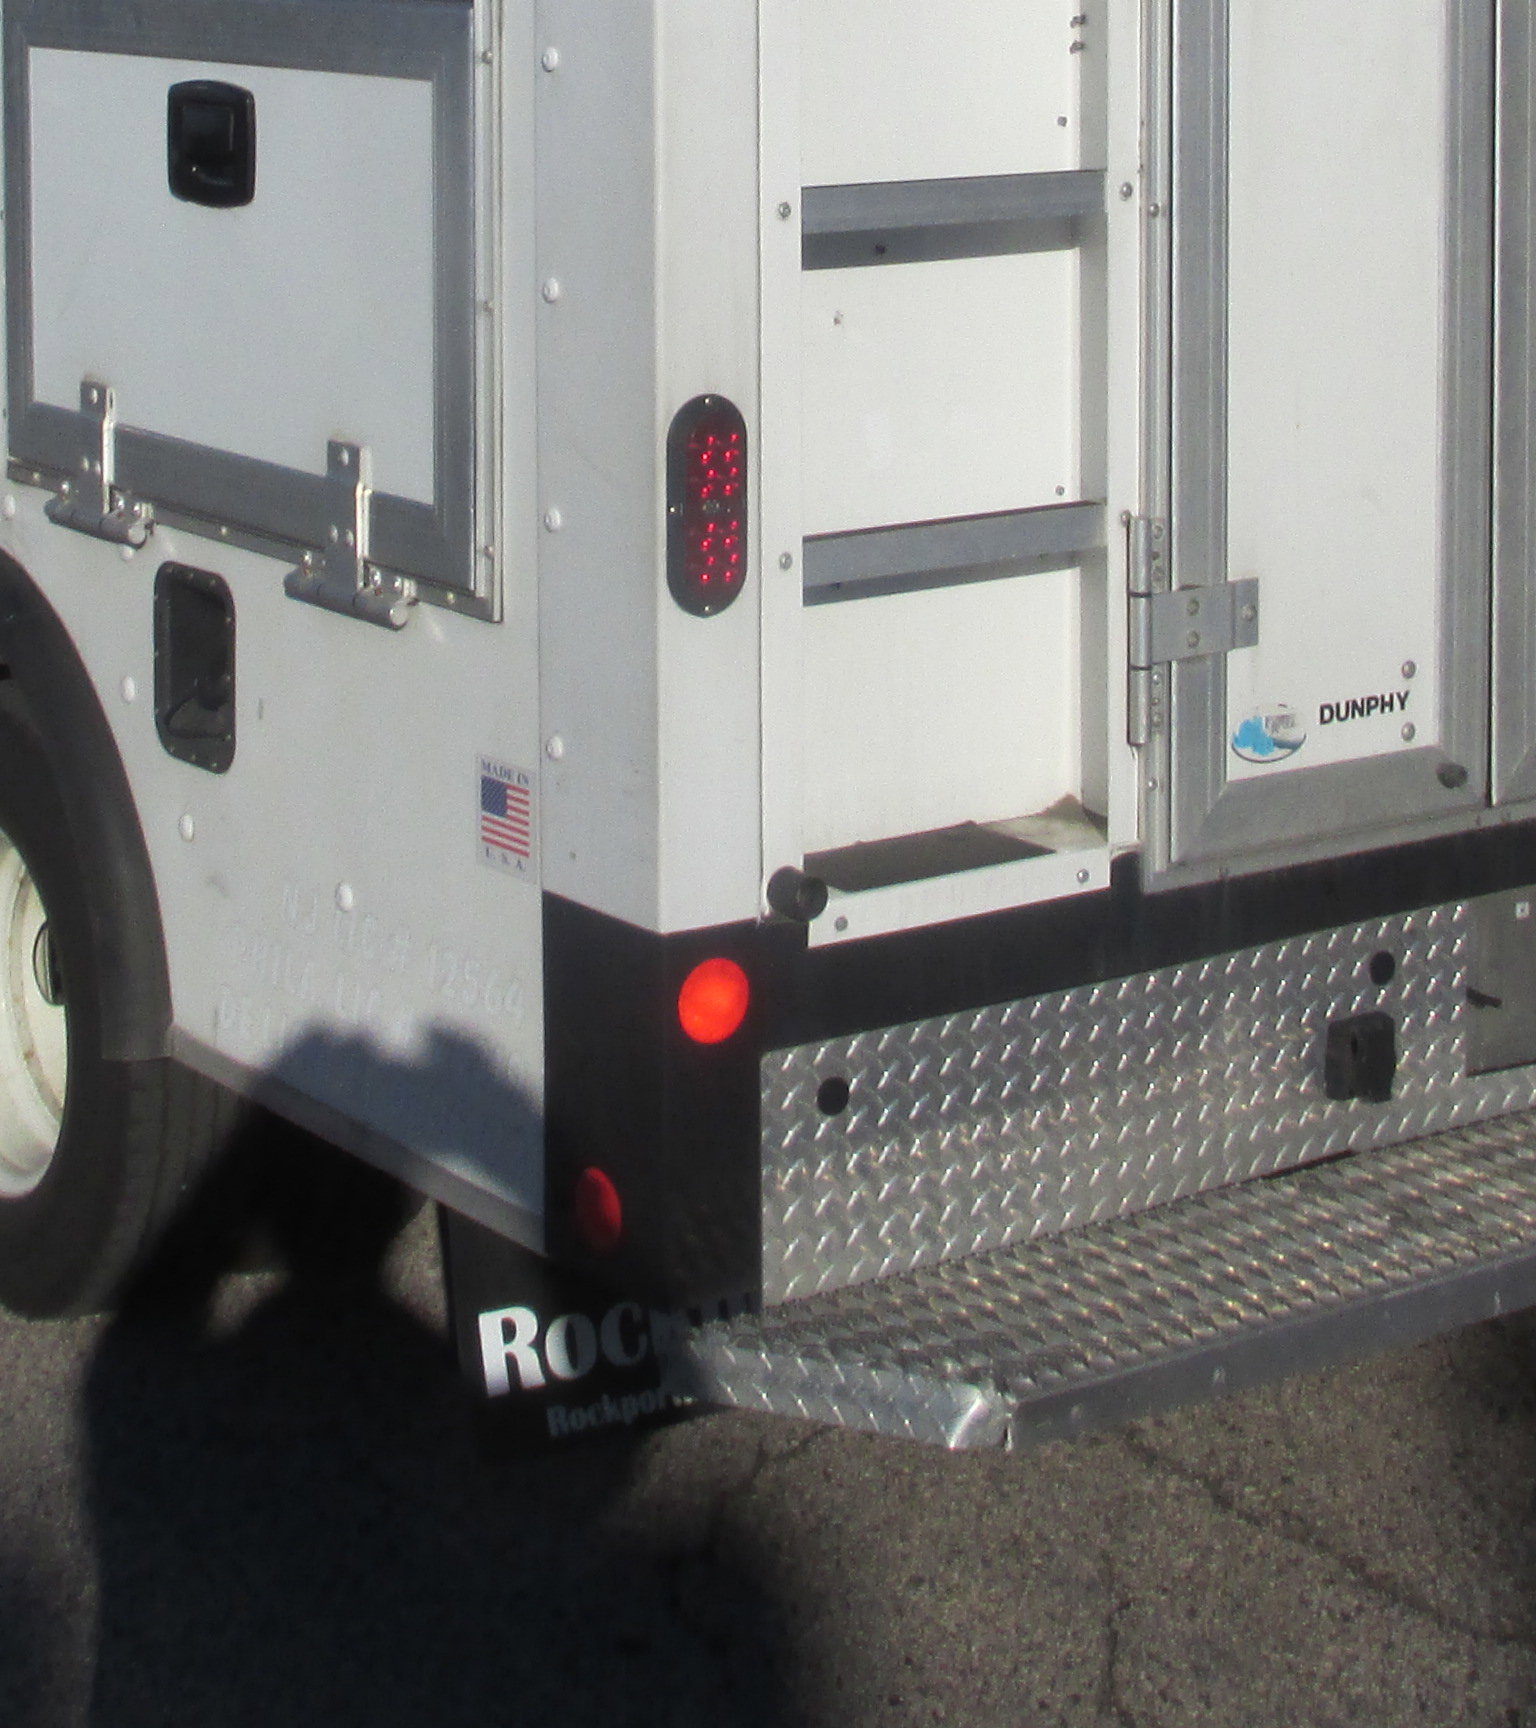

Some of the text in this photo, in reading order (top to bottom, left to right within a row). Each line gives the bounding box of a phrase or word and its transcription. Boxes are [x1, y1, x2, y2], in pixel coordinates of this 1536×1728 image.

[1319, 689, 1411, 726] DUNPHY
[481, 759, 530, 785] MADE IN
[546, 1389, 676, 1437] Rockpor
